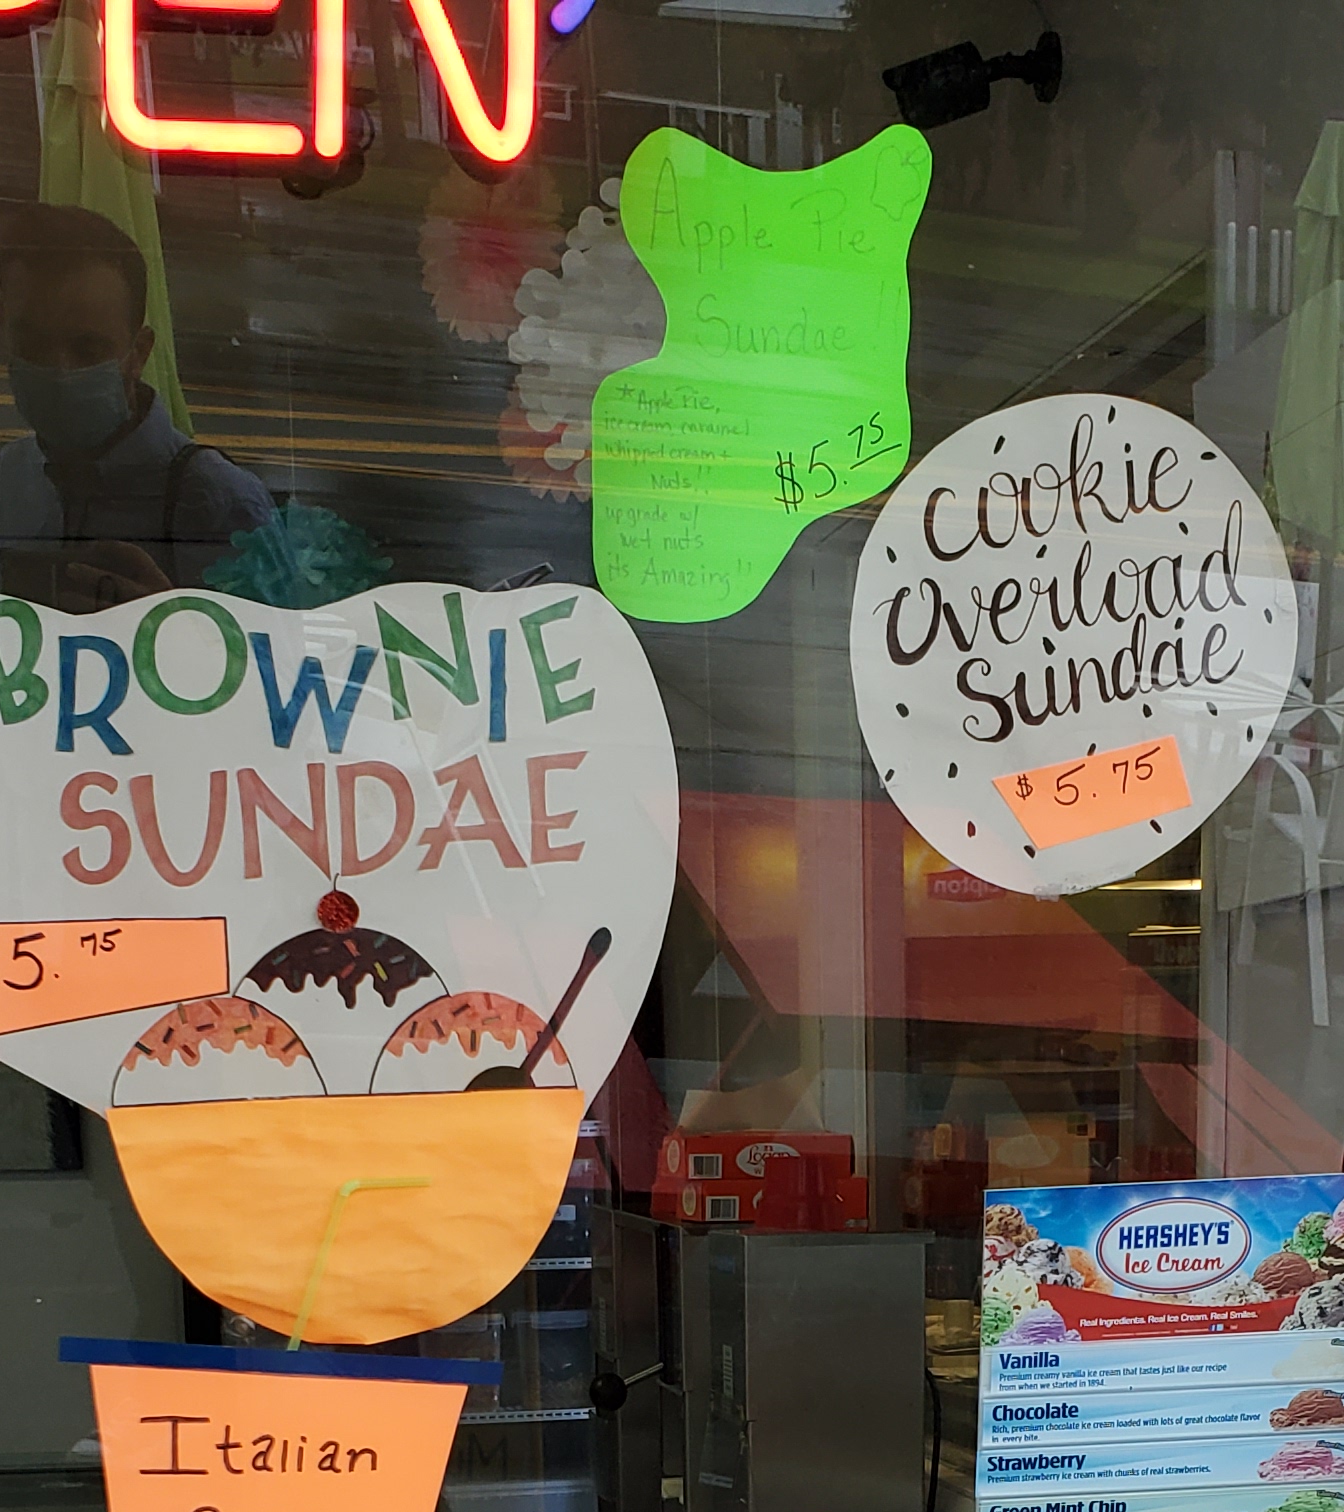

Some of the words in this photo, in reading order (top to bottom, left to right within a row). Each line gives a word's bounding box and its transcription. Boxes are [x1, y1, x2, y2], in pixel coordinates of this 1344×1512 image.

[649, 157, 773, 274] Apple
[790, 189, 877, 254] Pie
[956, 613, 1245, 743] Sundae
[59, 750, 591, 887] SUNDAE
[1119, 1221, 1230, 1250] HERSHEY'S
[1125, 1252, 1152, 1274] Ice
[1157, 1252, 1224, 1272] Cream
[1080, 1319, 1098, 1327] Real
[1148, 1315, 1165, 1323] Real
[1167, 1314, 1180, 1322] Ice
[1210, 1312, 1228, 1320] Real
[999, 1351, 1060, 1370] Vanilla
[992, 1403, 1079, 1421] Chocolate
[140, 1415, 378, 1475] Italian
[987, 1453, 1086, 1472] Strawberry
[987, 1473, 1020, 1483] Premium
[1022, 1472, 1060, 1483] strawberry
[1062, 1472, 1072, 1480] ice
[1073, 1471, 1095, 1479] cream
[1097, 1469, 1113, 1478] with
[1150, 1466, 1163, 1475] real
